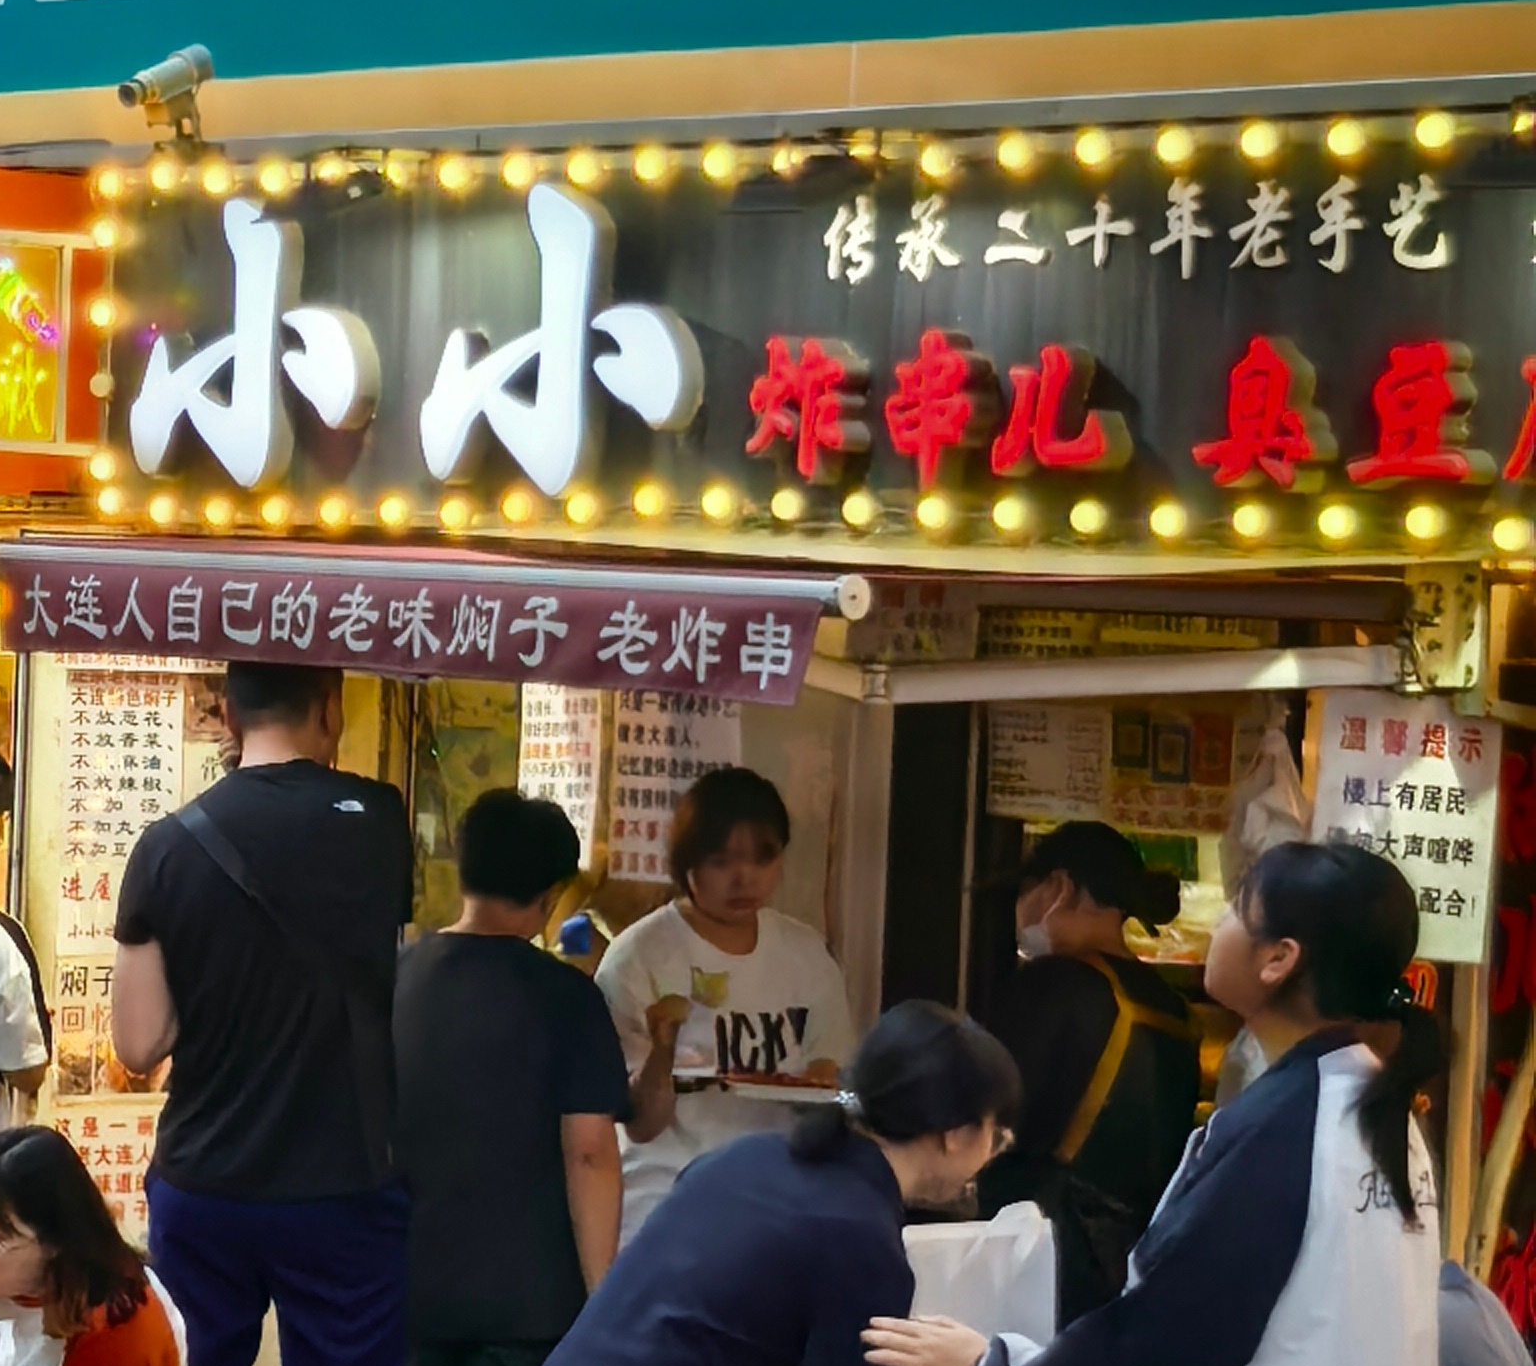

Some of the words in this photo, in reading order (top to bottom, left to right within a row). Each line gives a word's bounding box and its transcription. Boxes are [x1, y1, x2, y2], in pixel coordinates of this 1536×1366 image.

[822, 172, 1449, 283] 传承二十年老手艺
[131, 183, 689, 497] 小小
[1192, 335, 1536, 488] 臭豆
[596, 600, 793, 691] 老炸串
